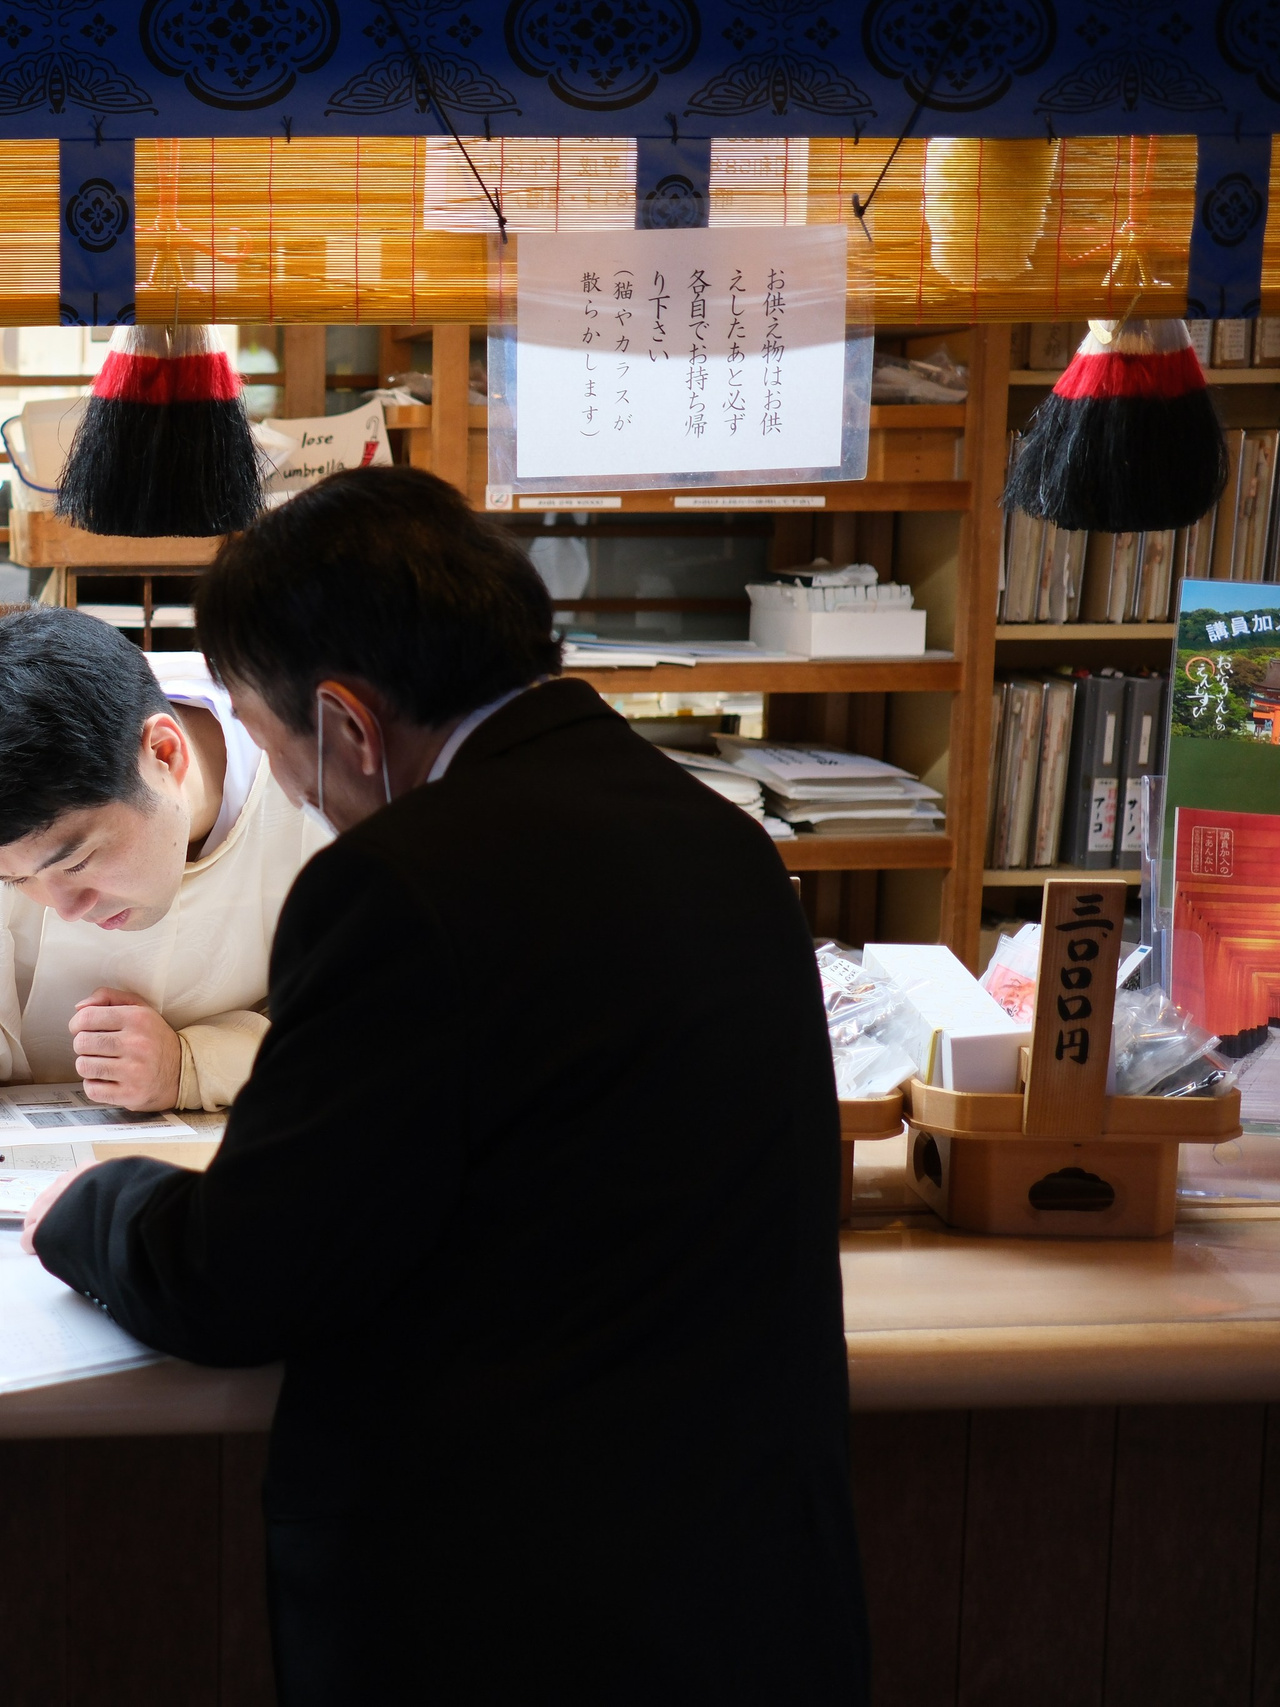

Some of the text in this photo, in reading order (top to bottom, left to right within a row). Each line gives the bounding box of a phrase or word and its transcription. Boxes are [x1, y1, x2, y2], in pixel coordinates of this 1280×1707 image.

[648, 270, 671, 363] り下さい
[684, 268, 712, 439] 各自でお持ち帰
[722, 269, 747, 438] えしたあと必ず
[760, 267, 786, 436] お供え物はお供
[300, 432, 334, 449] lose
[1205, 614, 1280, 643] 講員加
[1204, 830, 1216, 873] ごあんない
[1219, 831, 1231, 875] 講員加入の
